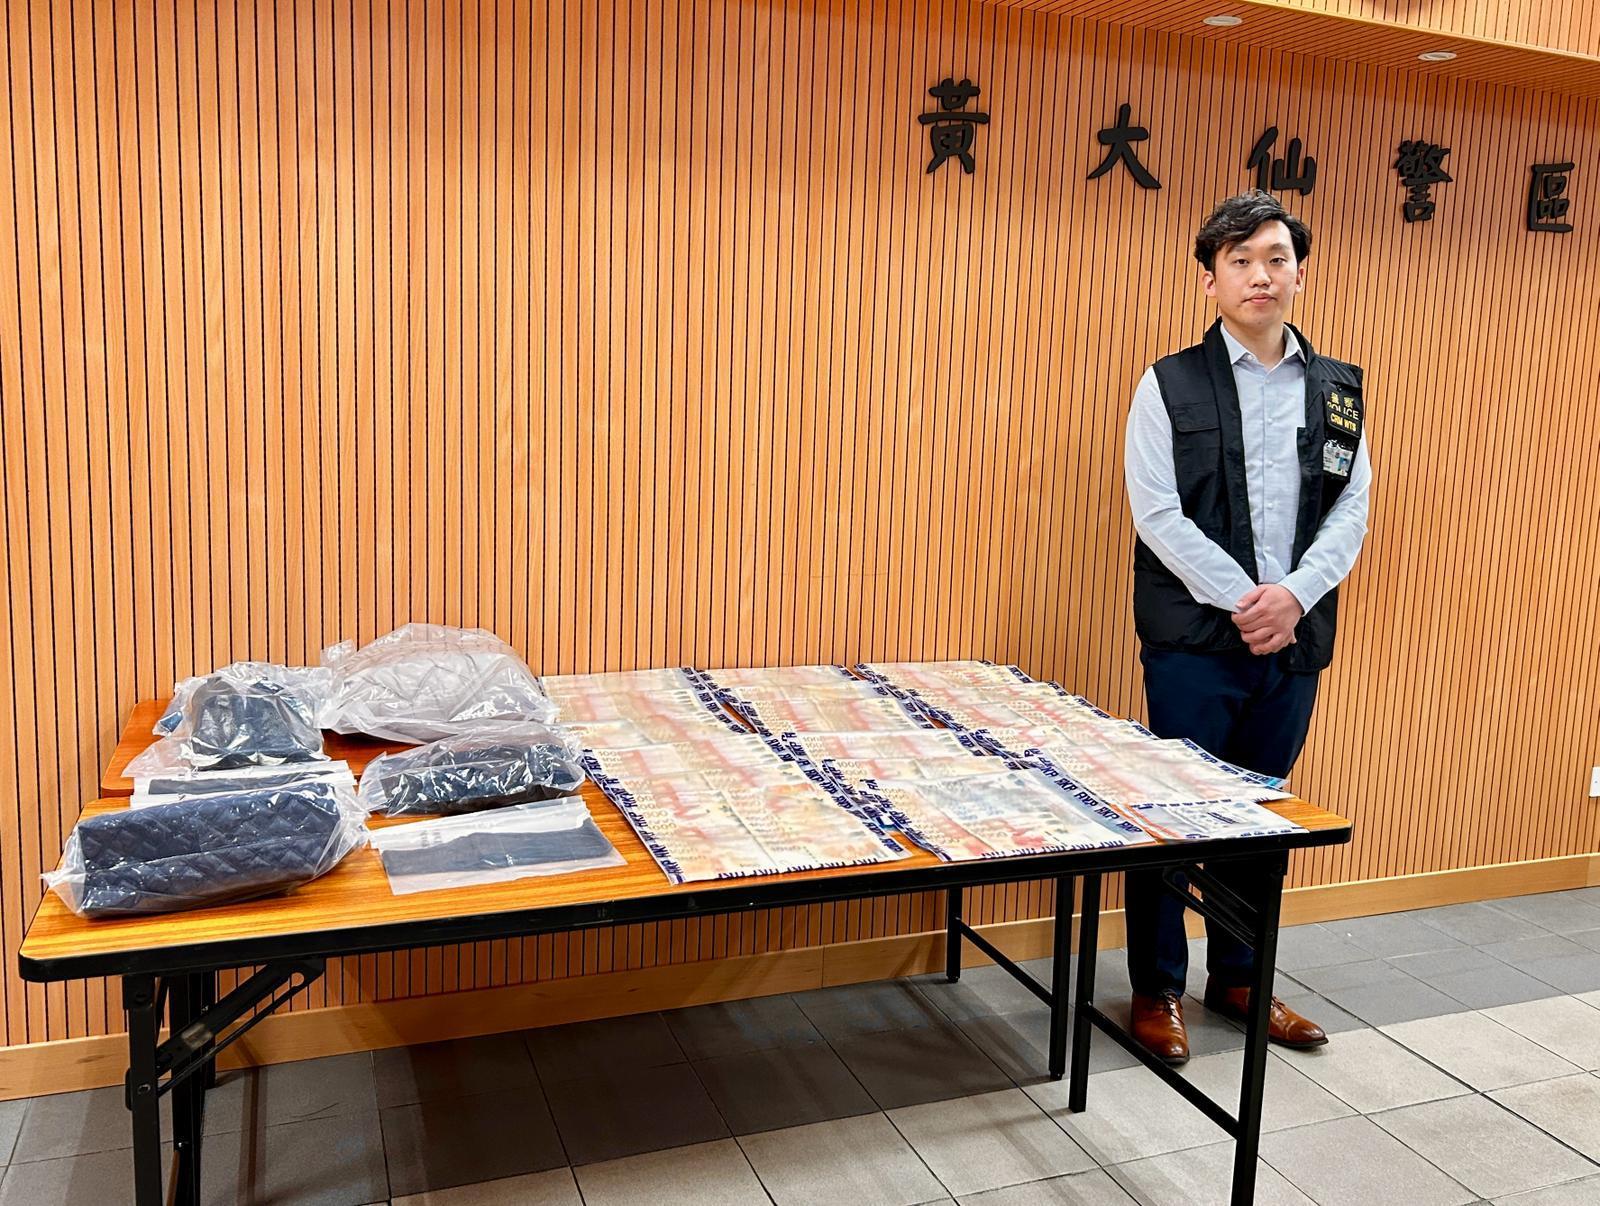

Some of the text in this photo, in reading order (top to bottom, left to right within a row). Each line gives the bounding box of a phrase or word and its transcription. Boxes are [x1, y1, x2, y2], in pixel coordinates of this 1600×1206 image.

[917, 78, 1574, 232] 黃大仙警區
[1327, 400, 1359, 420] POLICE
